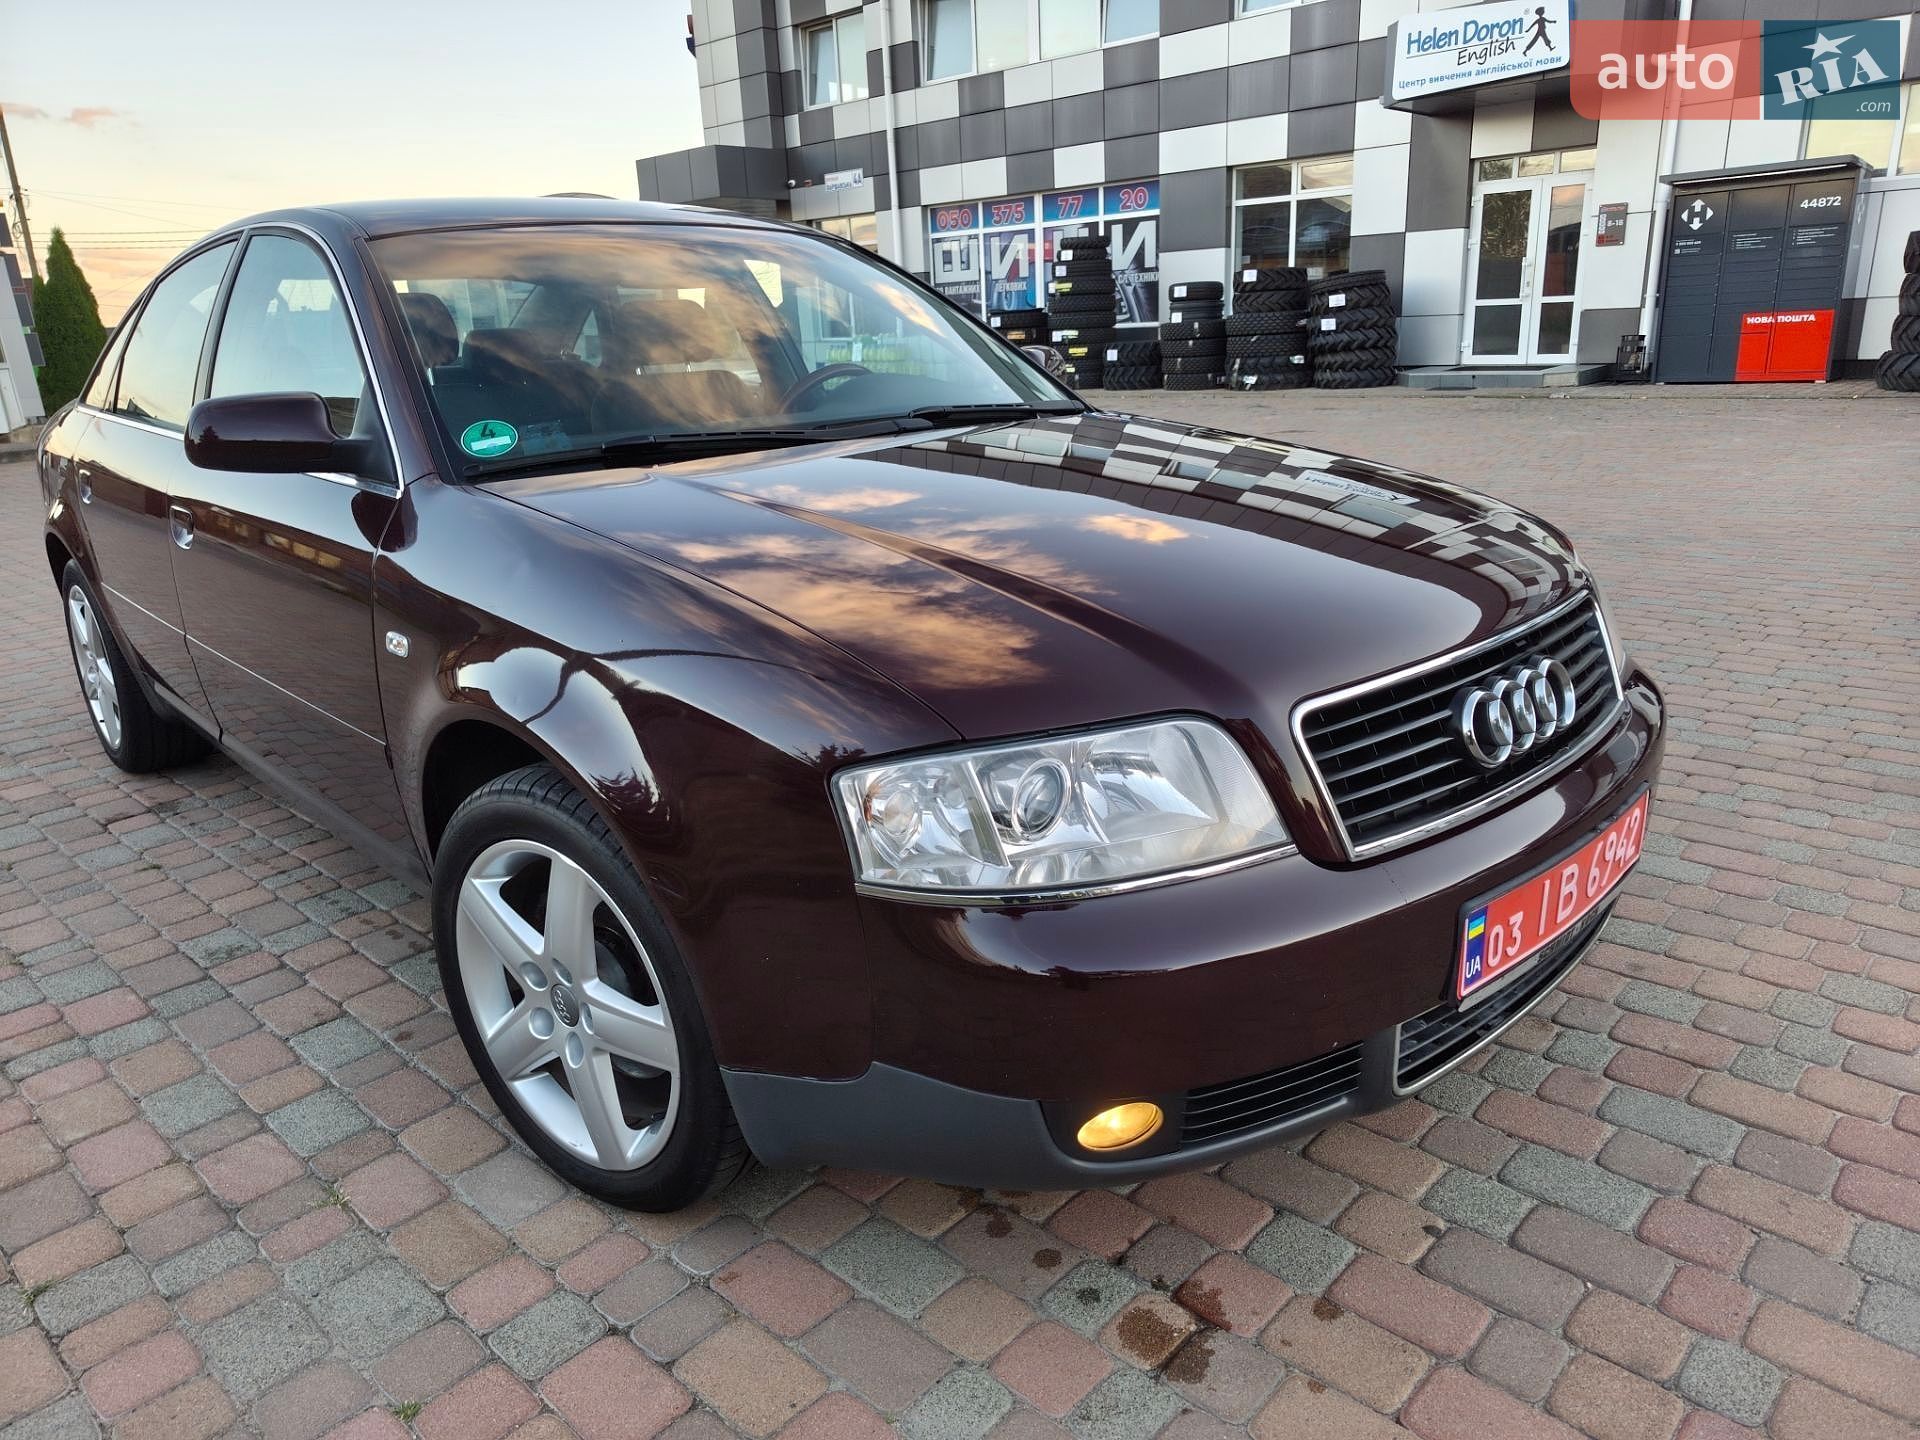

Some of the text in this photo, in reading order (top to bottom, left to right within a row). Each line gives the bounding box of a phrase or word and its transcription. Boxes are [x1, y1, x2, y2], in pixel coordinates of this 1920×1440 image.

[1406, 17, 1524, 55] Helen Doron
[1457, 37, 1516, 66] English
[1399, 55, 1562, 90] Центр вивчення англійської мови
[936, 186, 1149, 232] 050 375 77 20
[1800, 196, 1842, 209] 44872
[1747, 314, 1816, 324] НОВА ПОШТА
[480, 423, 496, 438] 4
[1487, 910, 1524, 968] 03
[1586, 806, 1642, 898] 6942
[1466, 954, 1482, 979] UA
